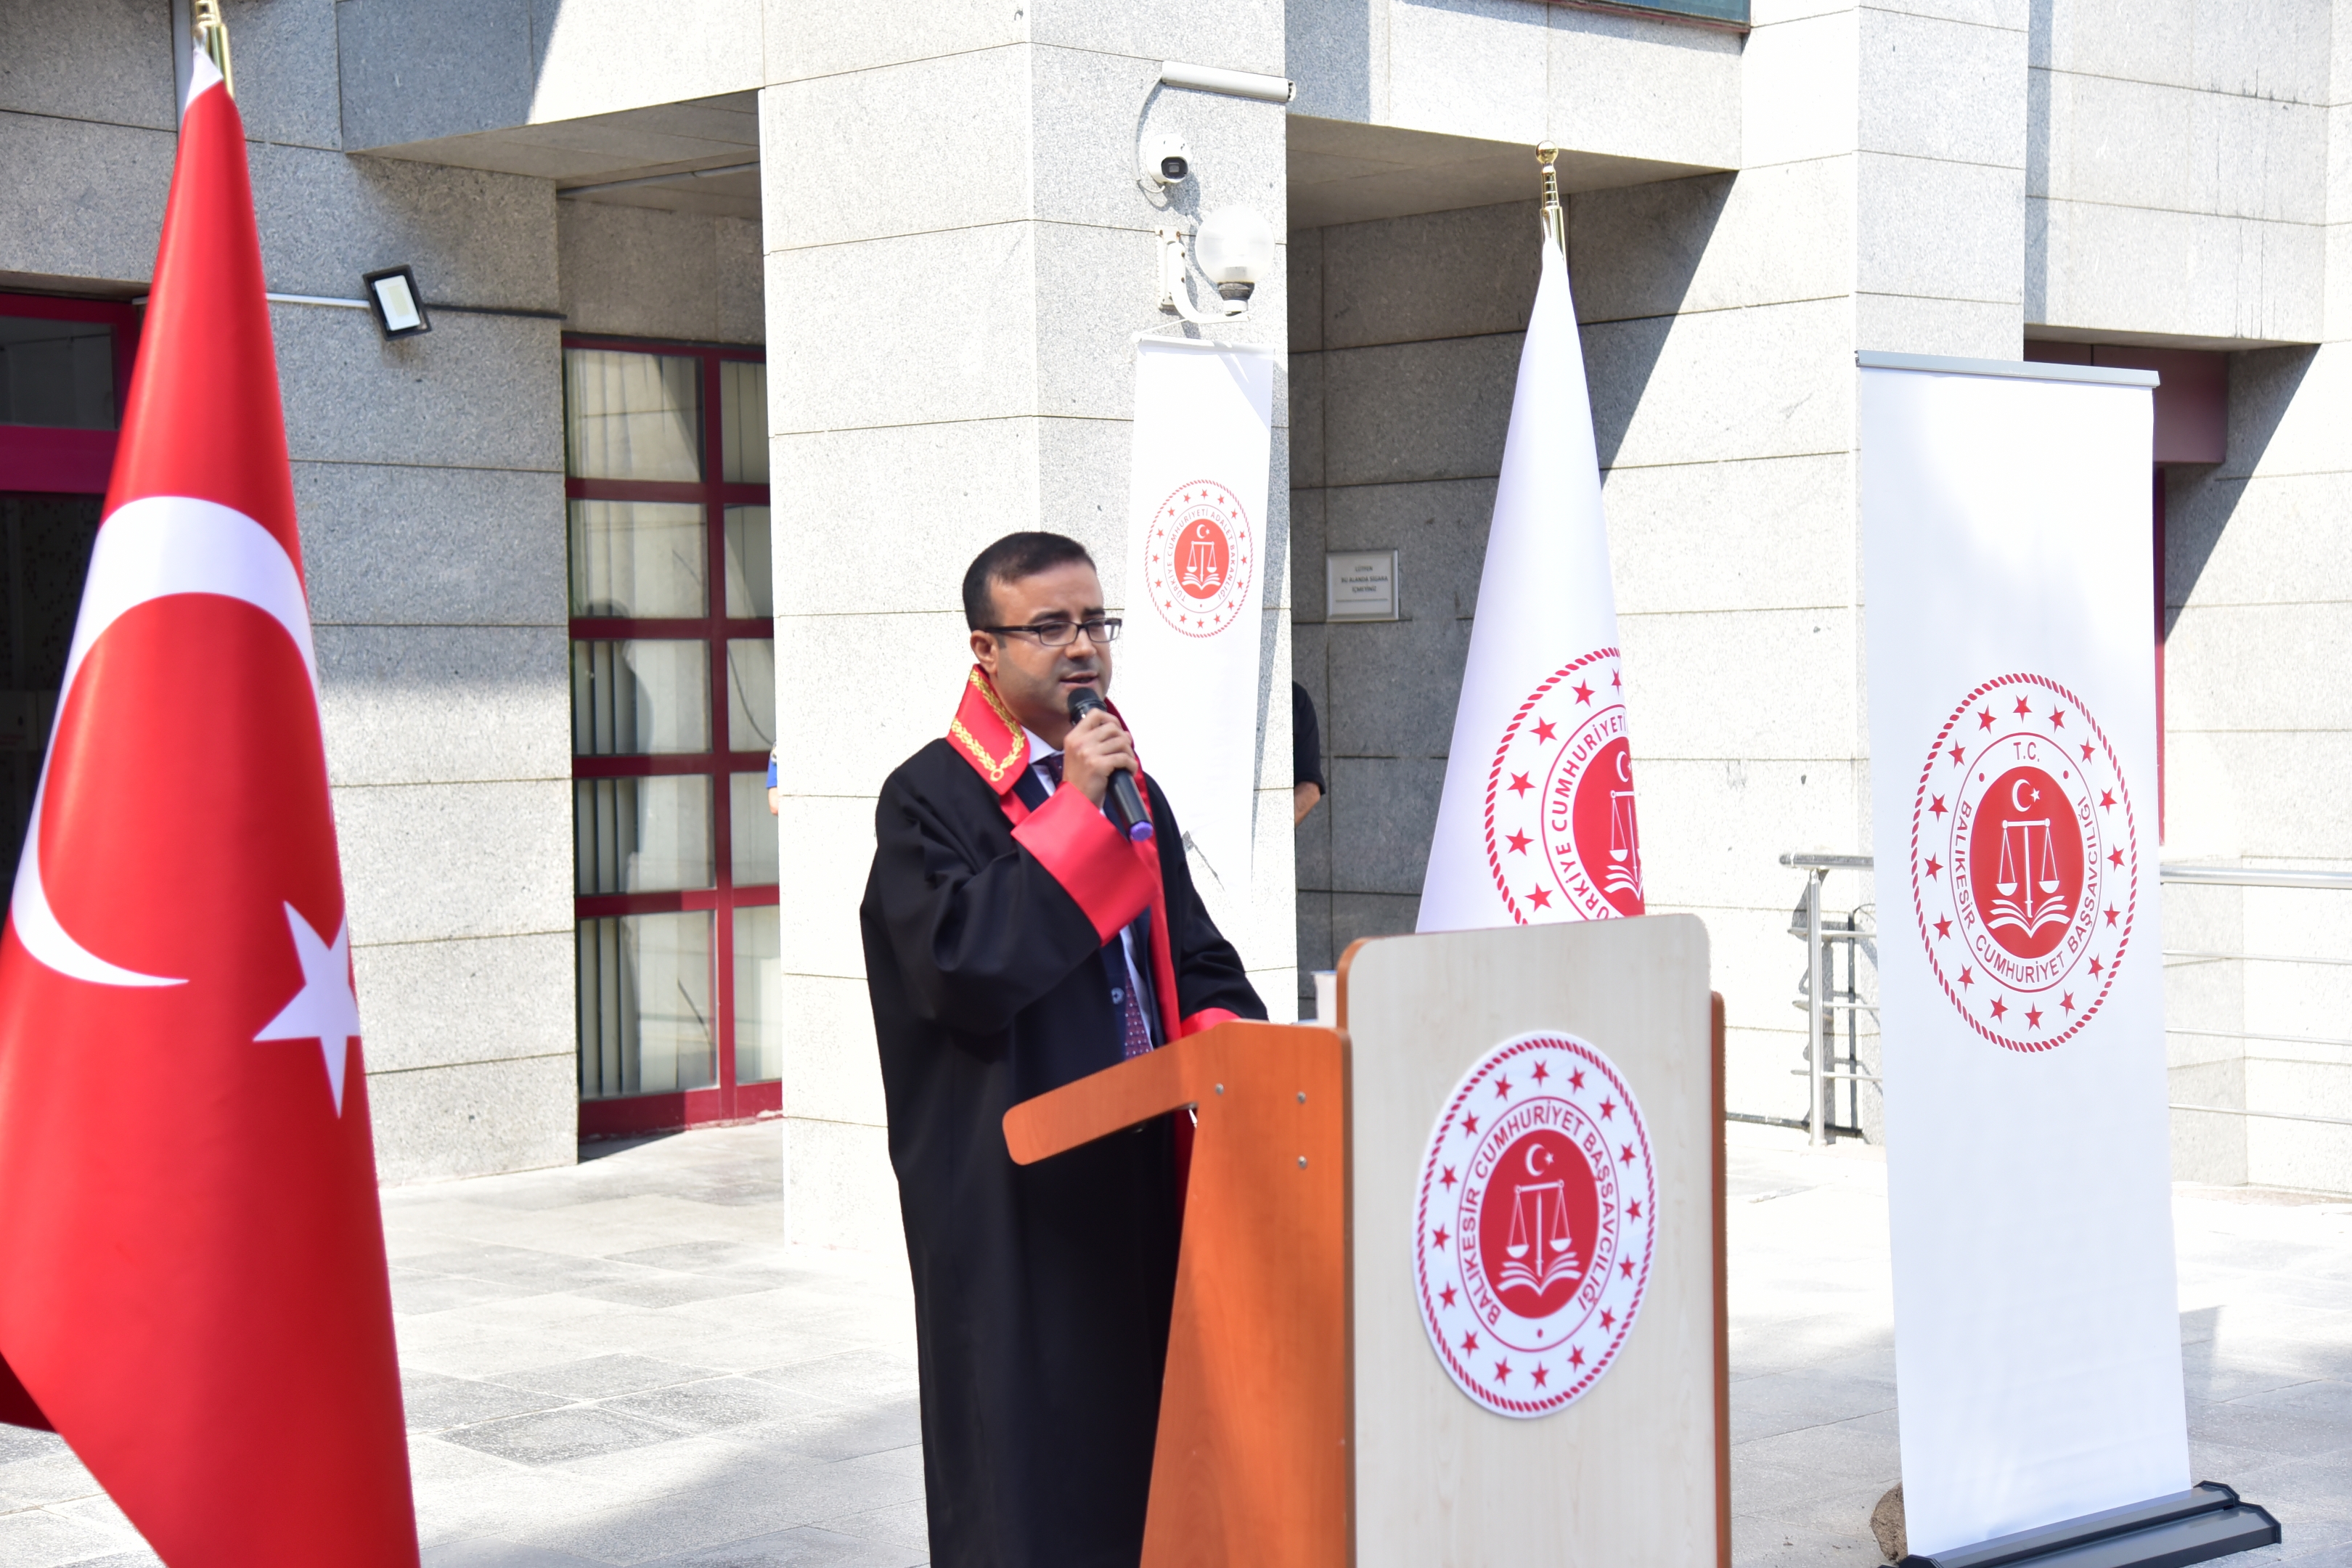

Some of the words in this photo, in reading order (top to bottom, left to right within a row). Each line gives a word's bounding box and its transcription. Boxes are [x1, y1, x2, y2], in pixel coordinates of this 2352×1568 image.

[1167, 507, 1208, 557] CUMHURİYETİ
[1210, 511, 1233, 540] ADALET
[1167, 561, 1186, 603] TÜRKİYE
[1218, 544, 1236, 600] BAKANLIĞI
[2013, 742, 2040, 762] T.C.
[1556, 842, 1618, 920] ÜRKİYE
[1955, 800, 1975, 931] BALIKESİR
[1975, 934, 2065, 984] CUMHURİYET
[2067, 796, 2098, 955] BAŞSAVCILIĞI
[1474, 1100, 1585, 1180] CUMHURİYET
[1577, 1132, 1615, 1311] BAŞSAVCILIĞI
[1461, 1187, 1502, 1326] BALIKESİR
